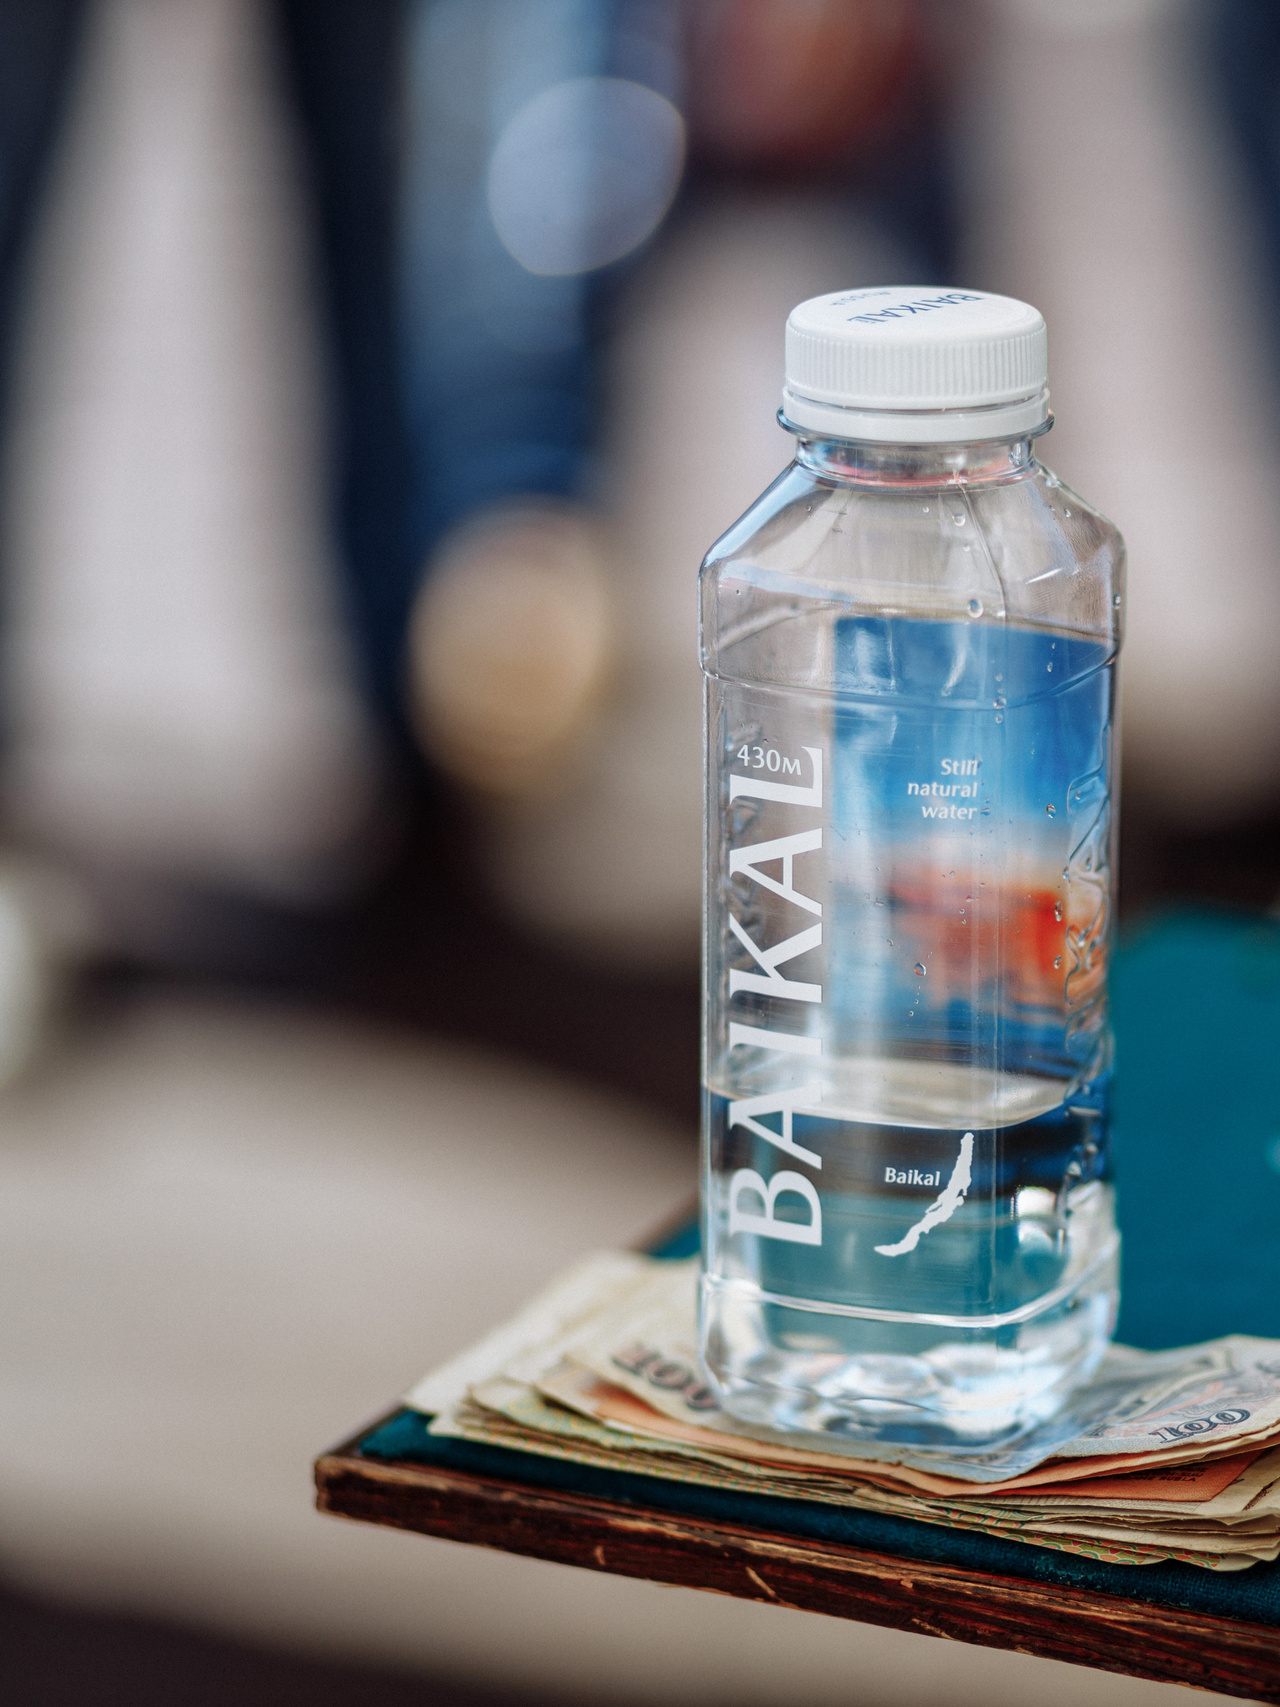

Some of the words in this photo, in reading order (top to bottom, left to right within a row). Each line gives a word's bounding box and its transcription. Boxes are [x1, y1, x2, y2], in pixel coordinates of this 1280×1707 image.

[846, 293, 984, 323] BAIKAL
[940, 758, 979, 776] Still
[907, 782, 978, 798] natural
[922, 804, 978, 820] water
[729, 745, 823, 1246] BAIKAL
[884, 1167, 941, 1187] Baikal
[1148, 1408, 1251, 1444] 100
